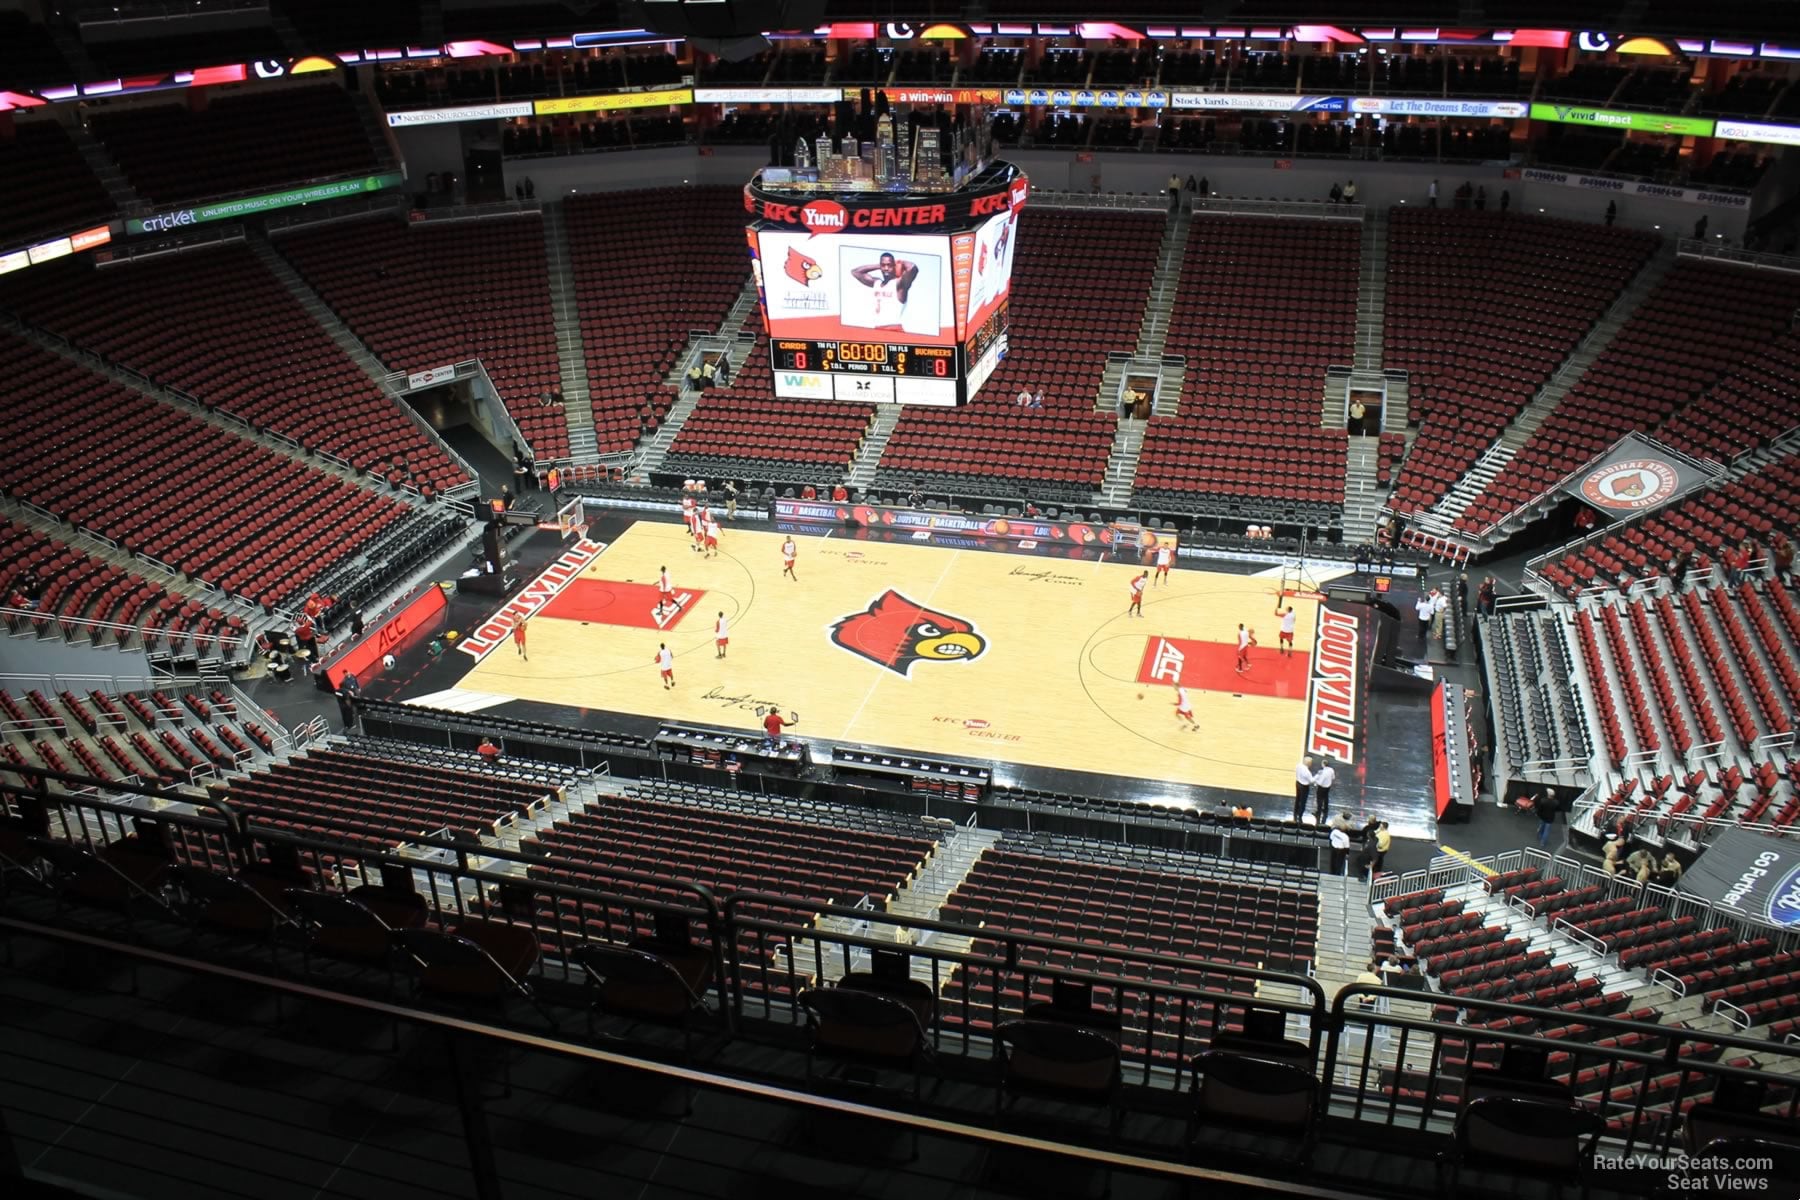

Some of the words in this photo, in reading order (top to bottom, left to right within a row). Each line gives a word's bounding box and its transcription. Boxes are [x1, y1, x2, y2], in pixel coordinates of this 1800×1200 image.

[900, 92, 906, 102] a
[909, 90, 953, 102] win-win
[1174, 96, 1200, 105] Stock
[1204, 98, 1229, 106] Yards
[1232, 98, 1254, 106] Bank
[1268, 98, 1294, 108] Trust
[1390, 102, 1404, 110] Let
[1406, 102, 1423, 111] The
[1424, 102, 1458, 112] Dreams
[1462, 104, 1488, 115] Begin
[202, 203, 244, 217] UNLIMITED
[244, 199, 268, 210] MUSIC
[269, 197, 281, 206] ON
[282, 192, 303, 203] YOUR
[304, 186, 340, 199] WIRELESS
[340, 182, 360, 192] PLAN
[970, 191, 1010, 217] KFC
[143, 209, 197, 232] cricket
[764, 201, 799, 224] KFC
[803, 208, 845, 227] Yum!
[853, 204, 947, 228] CENTER
[796, 352, 806, 368] 0
[826, 350, 834, 360] 0
[840, 344, 885, 361] 60:00
[898, 353, 906, 362] 0
[935, 359, 946, 376] 0
[784, 374, 820, 387] WM
[1588, 461, 1644, 483] CARDINAL
[1646, 462, 1674, 493] ATHLETIC
[935, 519, 979, 530] BASKETBALL
[456, 538, 608, 664] LOUISVILLE
[378, 616, 406, 653] ACC
[1154, 641, 1185, 683] ACC
[1308, 604, 1359, 764] LOUISVILLE
[968, 730, 1021, 741] CENTER
[1754, 851, 1780, 868] Go
[1722, 866, 1768, 906] Further
